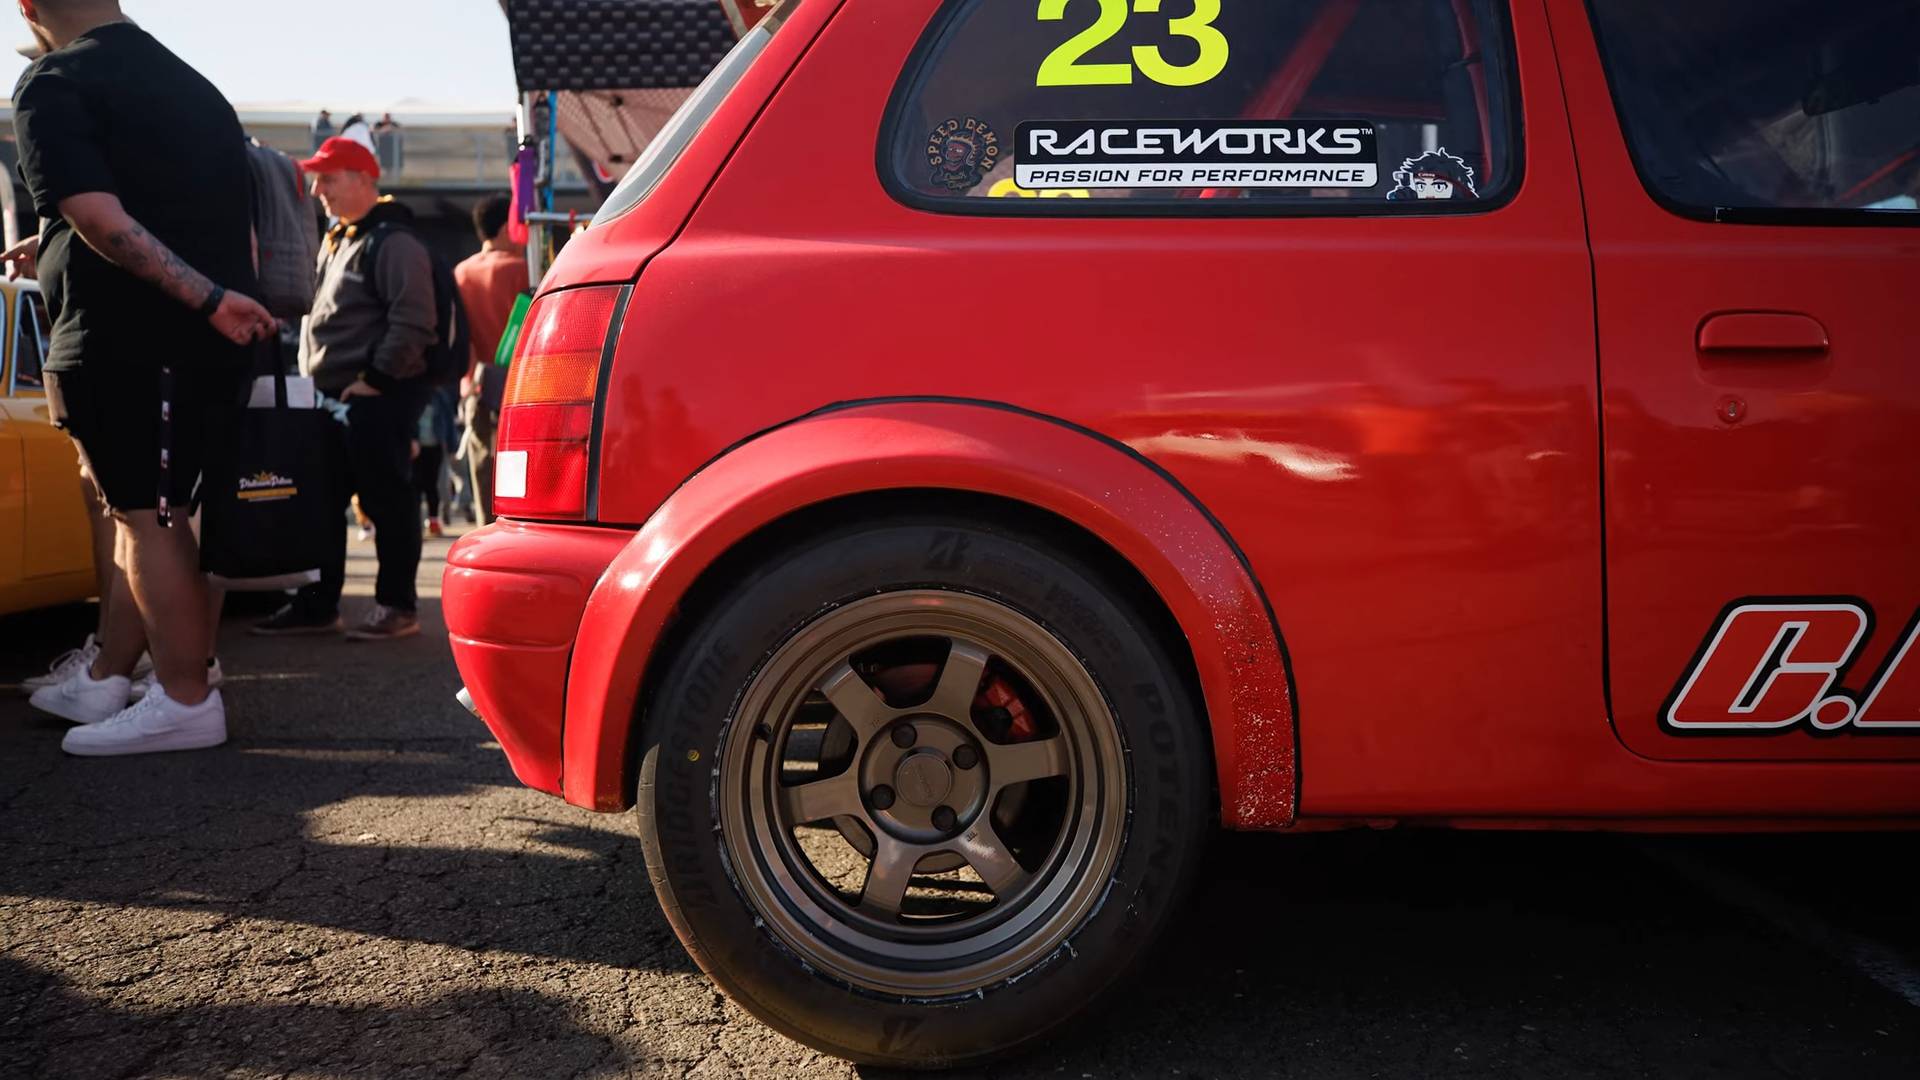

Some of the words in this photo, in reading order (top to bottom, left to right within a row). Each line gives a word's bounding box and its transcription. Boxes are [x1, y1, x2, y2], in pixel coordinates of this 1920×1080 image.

[1036, 0, 1229, 86] 23
[928, 119, 959, 166] SPEED
[965, 118, 998, 169] DEMON
[1030, 170, 1129, 182] PASSION
[1138, 169, 1183, 182] FOR
[1191, 169, 1365, 182] PERFORMANCE
